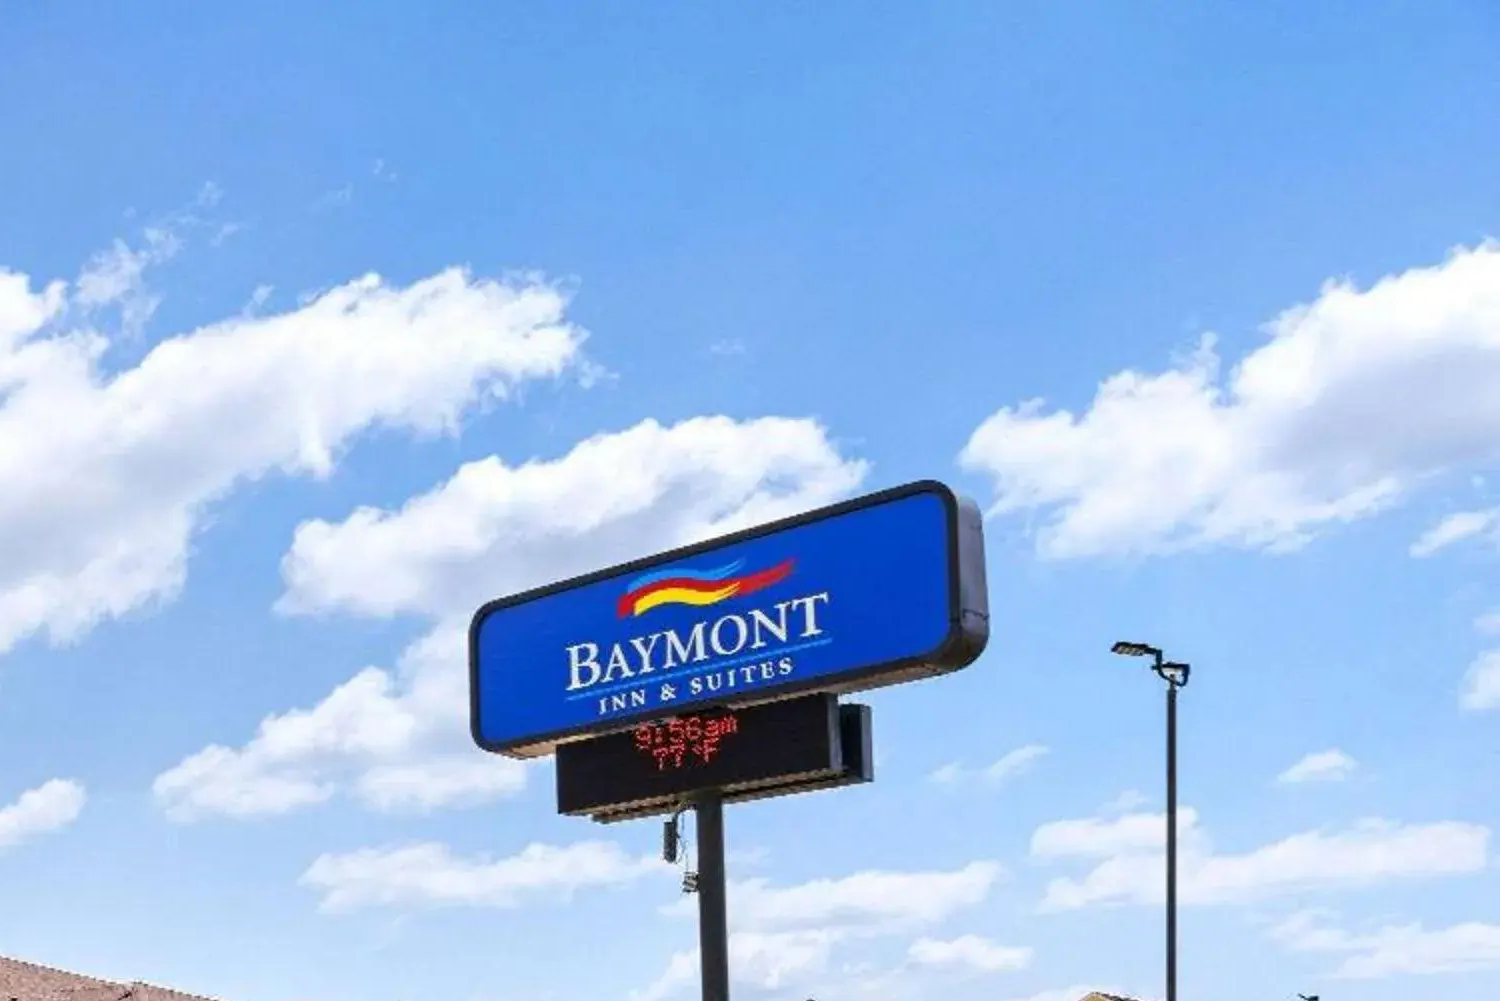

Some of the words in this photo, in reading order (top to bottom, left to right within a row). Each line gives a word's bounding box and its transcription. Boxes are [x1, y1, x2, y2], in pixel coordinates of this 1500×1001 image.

[565, 592, 829, 691] BAYMONT
[599, 689, 645, 715] INN
[660, 683, 677, 701] &
[691, 657, 794, 695] SUITES
